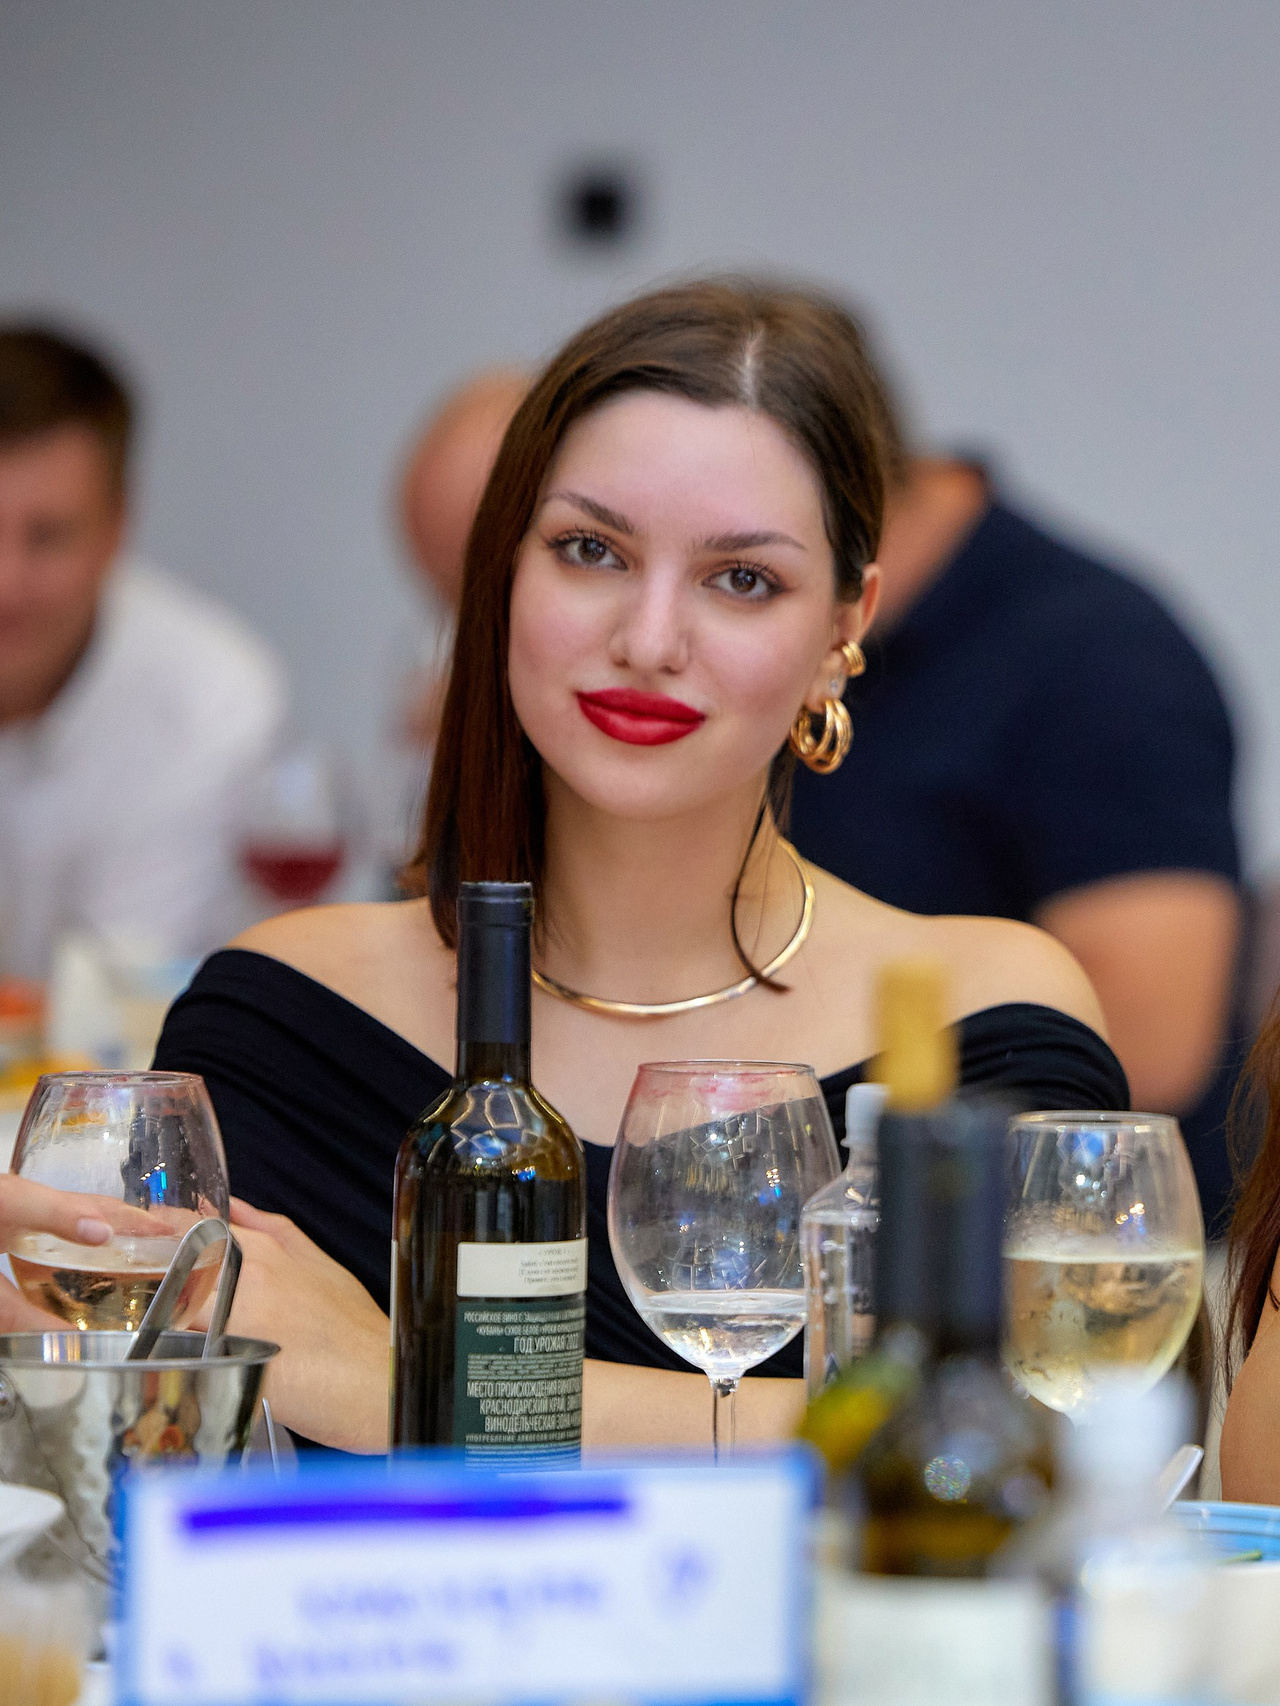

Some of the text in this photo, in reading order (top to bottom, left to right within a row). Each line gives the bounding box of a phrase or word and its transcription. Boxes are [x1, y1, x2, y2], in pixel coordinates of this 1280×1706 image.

[514, 1336, 533, 1353] ГОД
[534, 1335, 565, 1353] УРОЖАЯ
[467, 1381, 494, 1397] МЕСТО
[495, 1379, 556, 1397] ПРОИСХОЖДЕНИЯ
[480, 1397, 548, 1416] КРАСНОДАРСКИЙ
[485, 1415, 556, 1434] ВИНОДЕЛЬЧЕСКАЯ
[466, 1434, 515, 1443] УПОТРЕБЛЕНИЕ
[517, 1433, 548, 1443] АЛКОГОЛЯ
